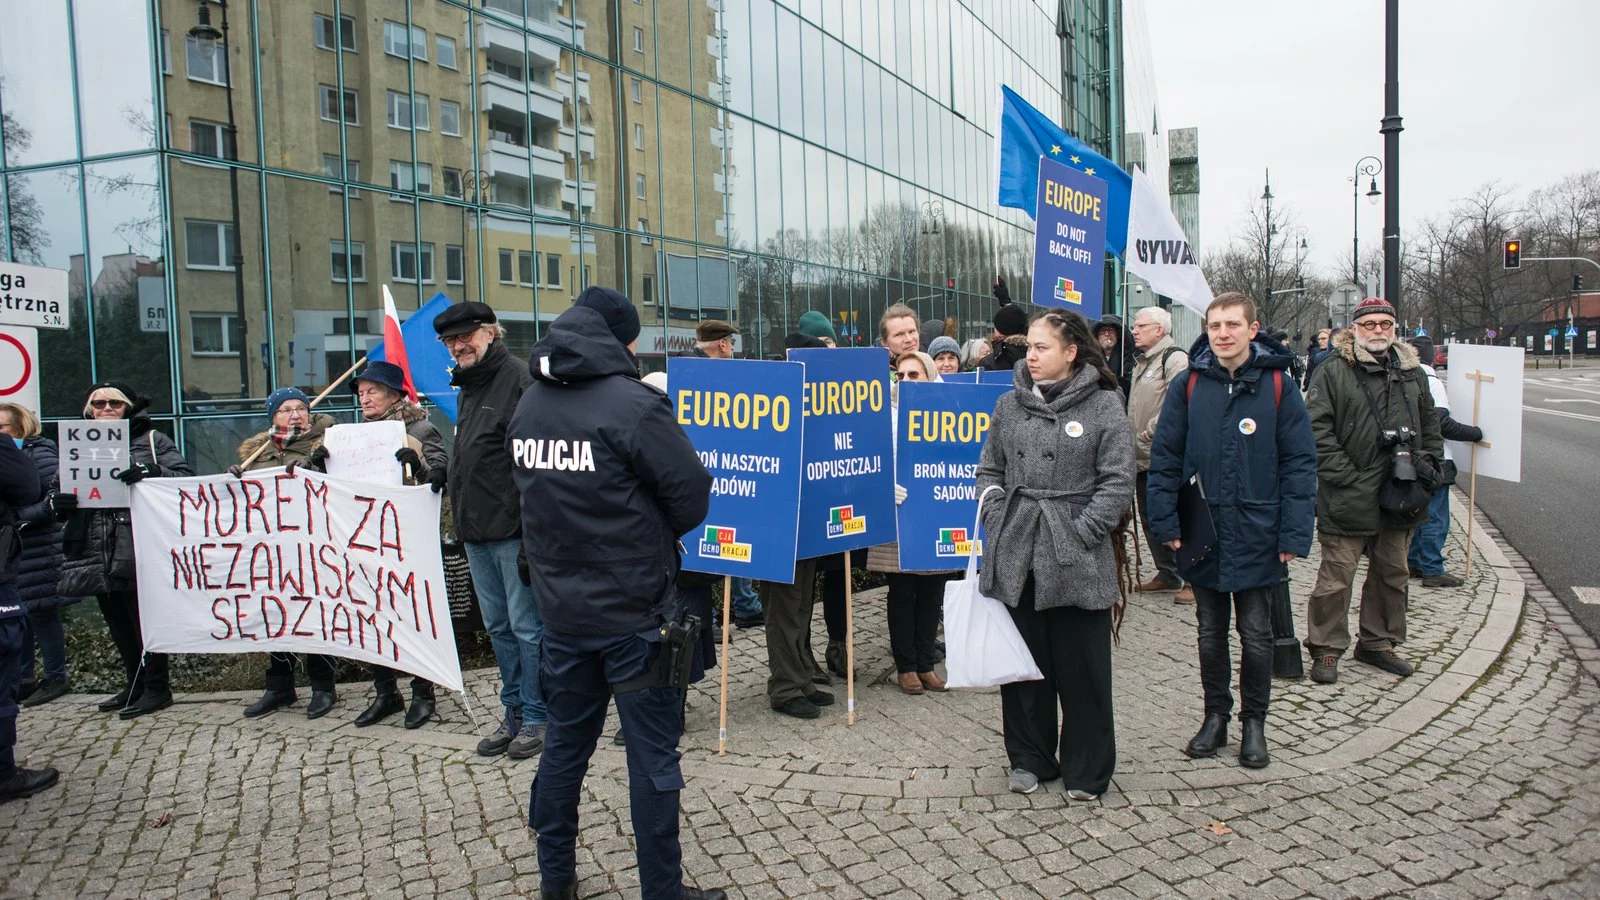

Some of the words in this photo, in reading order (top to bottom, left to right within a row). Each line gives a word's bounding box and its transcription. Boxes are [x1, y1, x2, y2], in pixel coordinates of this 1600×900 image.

[1045, 179, 1102, 222] EUROPE
[1056, 221, 1069, 238] DO
[1069, 227, 1087, 244] NOT
[1049, 239, 1072, 260] BACK
[1073, 248, 1092, 265] OFF!
[0, 294, 60, 313] trzna
[43, 315, 65, 326] S.N.
[677, 389, 790, 432] EUROPO
[68, 428, 122, 441] KON
[908, 410, 991, 443] EUROP
[834, 431, 853, 450] NIE
[70, 448, 121, 461] STY
[512, 438, 596, 472] POLICJA
[696, 449, 718, 469] OŃ
[722, 453, 780, 474] NASZYCH
[70, 467, 121, 480] TUC
[807, 455, 881, 481] ODPUSZCZAJ!
[914, 461, 946, 479] BROŃ
[949, 463, 978, 479] NASZ
[711, 475, 756, 497] ĄDÓW!
[933, 482, 976, 503] SĄDÓW
[178, 474, 332, 541] MUREM
[347, 495, 404, 561] ZA
[171, 542, 437, 640] NIEZAWISŁYMI
[211, 594, 400, 662] SĘDZIAMI
